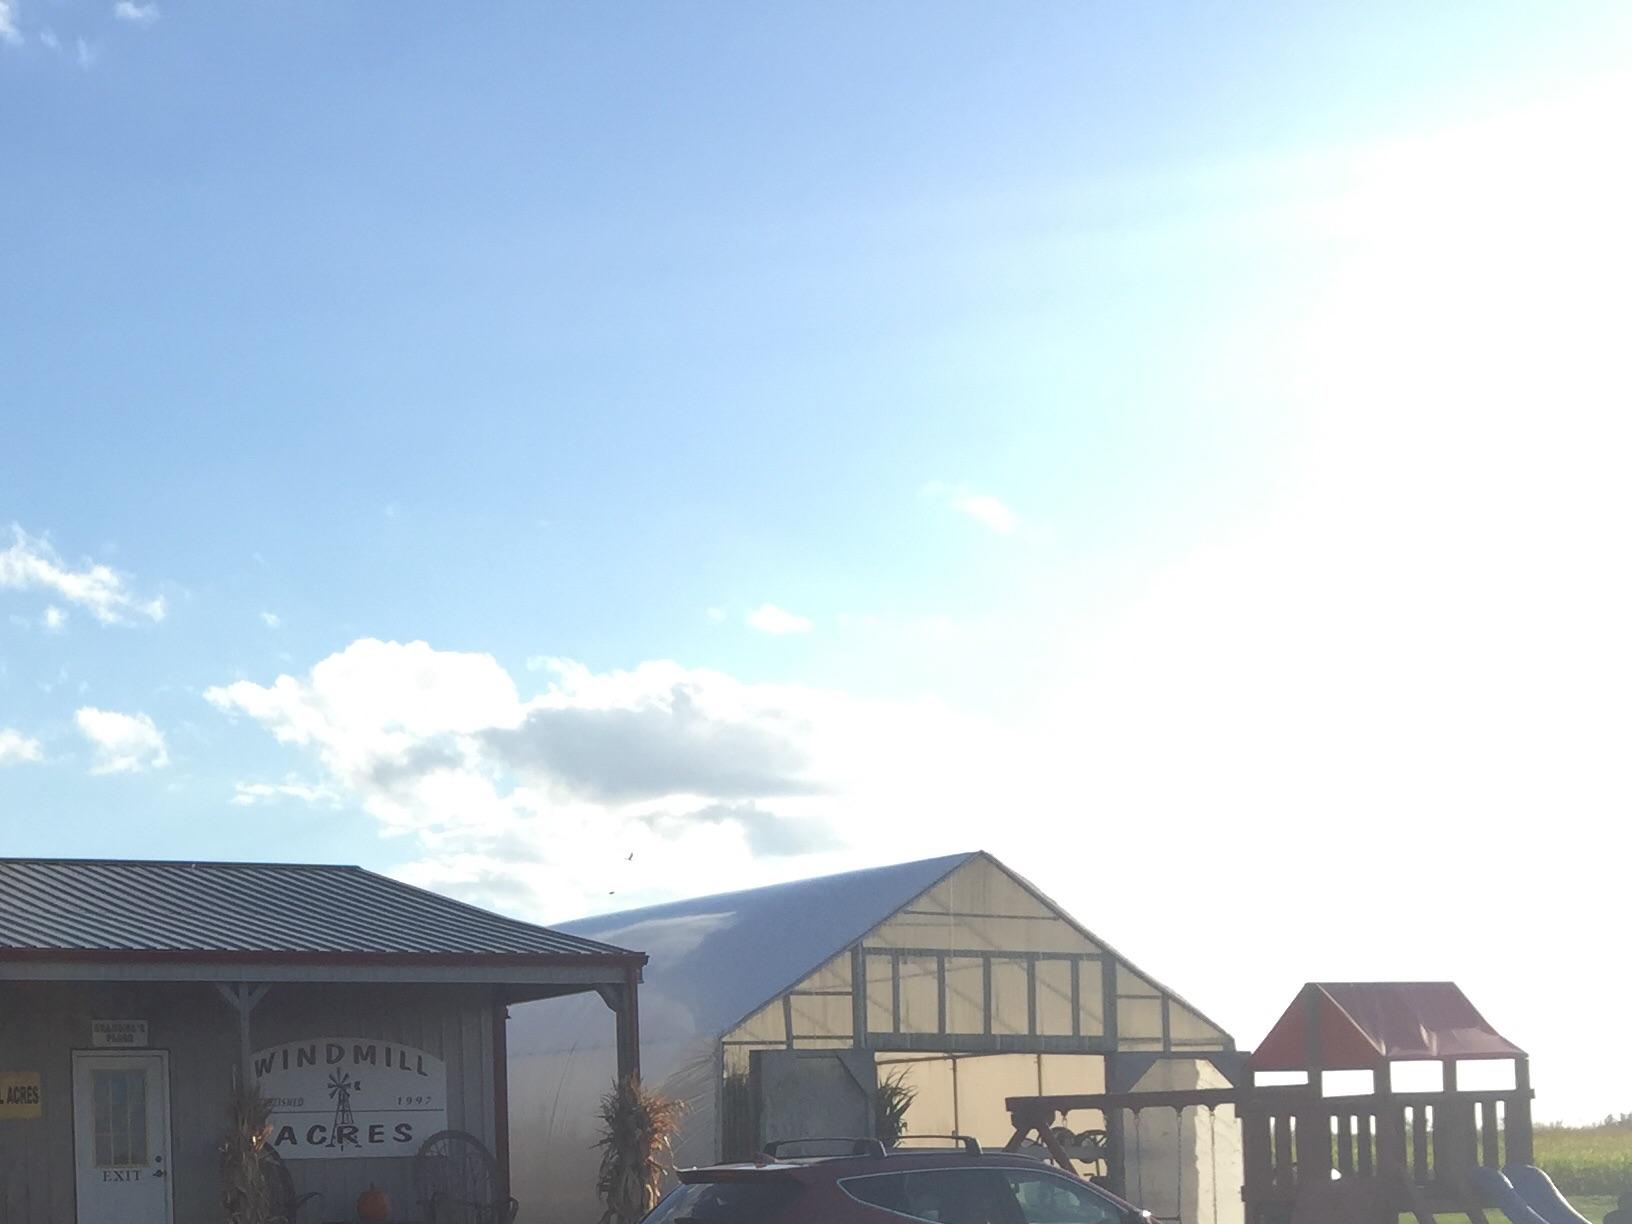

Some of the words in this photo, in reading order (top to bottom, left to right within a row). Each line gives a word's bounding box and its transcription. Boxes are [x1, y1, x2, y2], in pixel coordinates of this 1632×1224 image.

[254, 1043, 429, 1078] WINDMILL
[6, 1087, 40, 1106] ACRES
[274, 1122, 414, 1148] ACRES
[102, 1170, 143, 1183] EXIT
